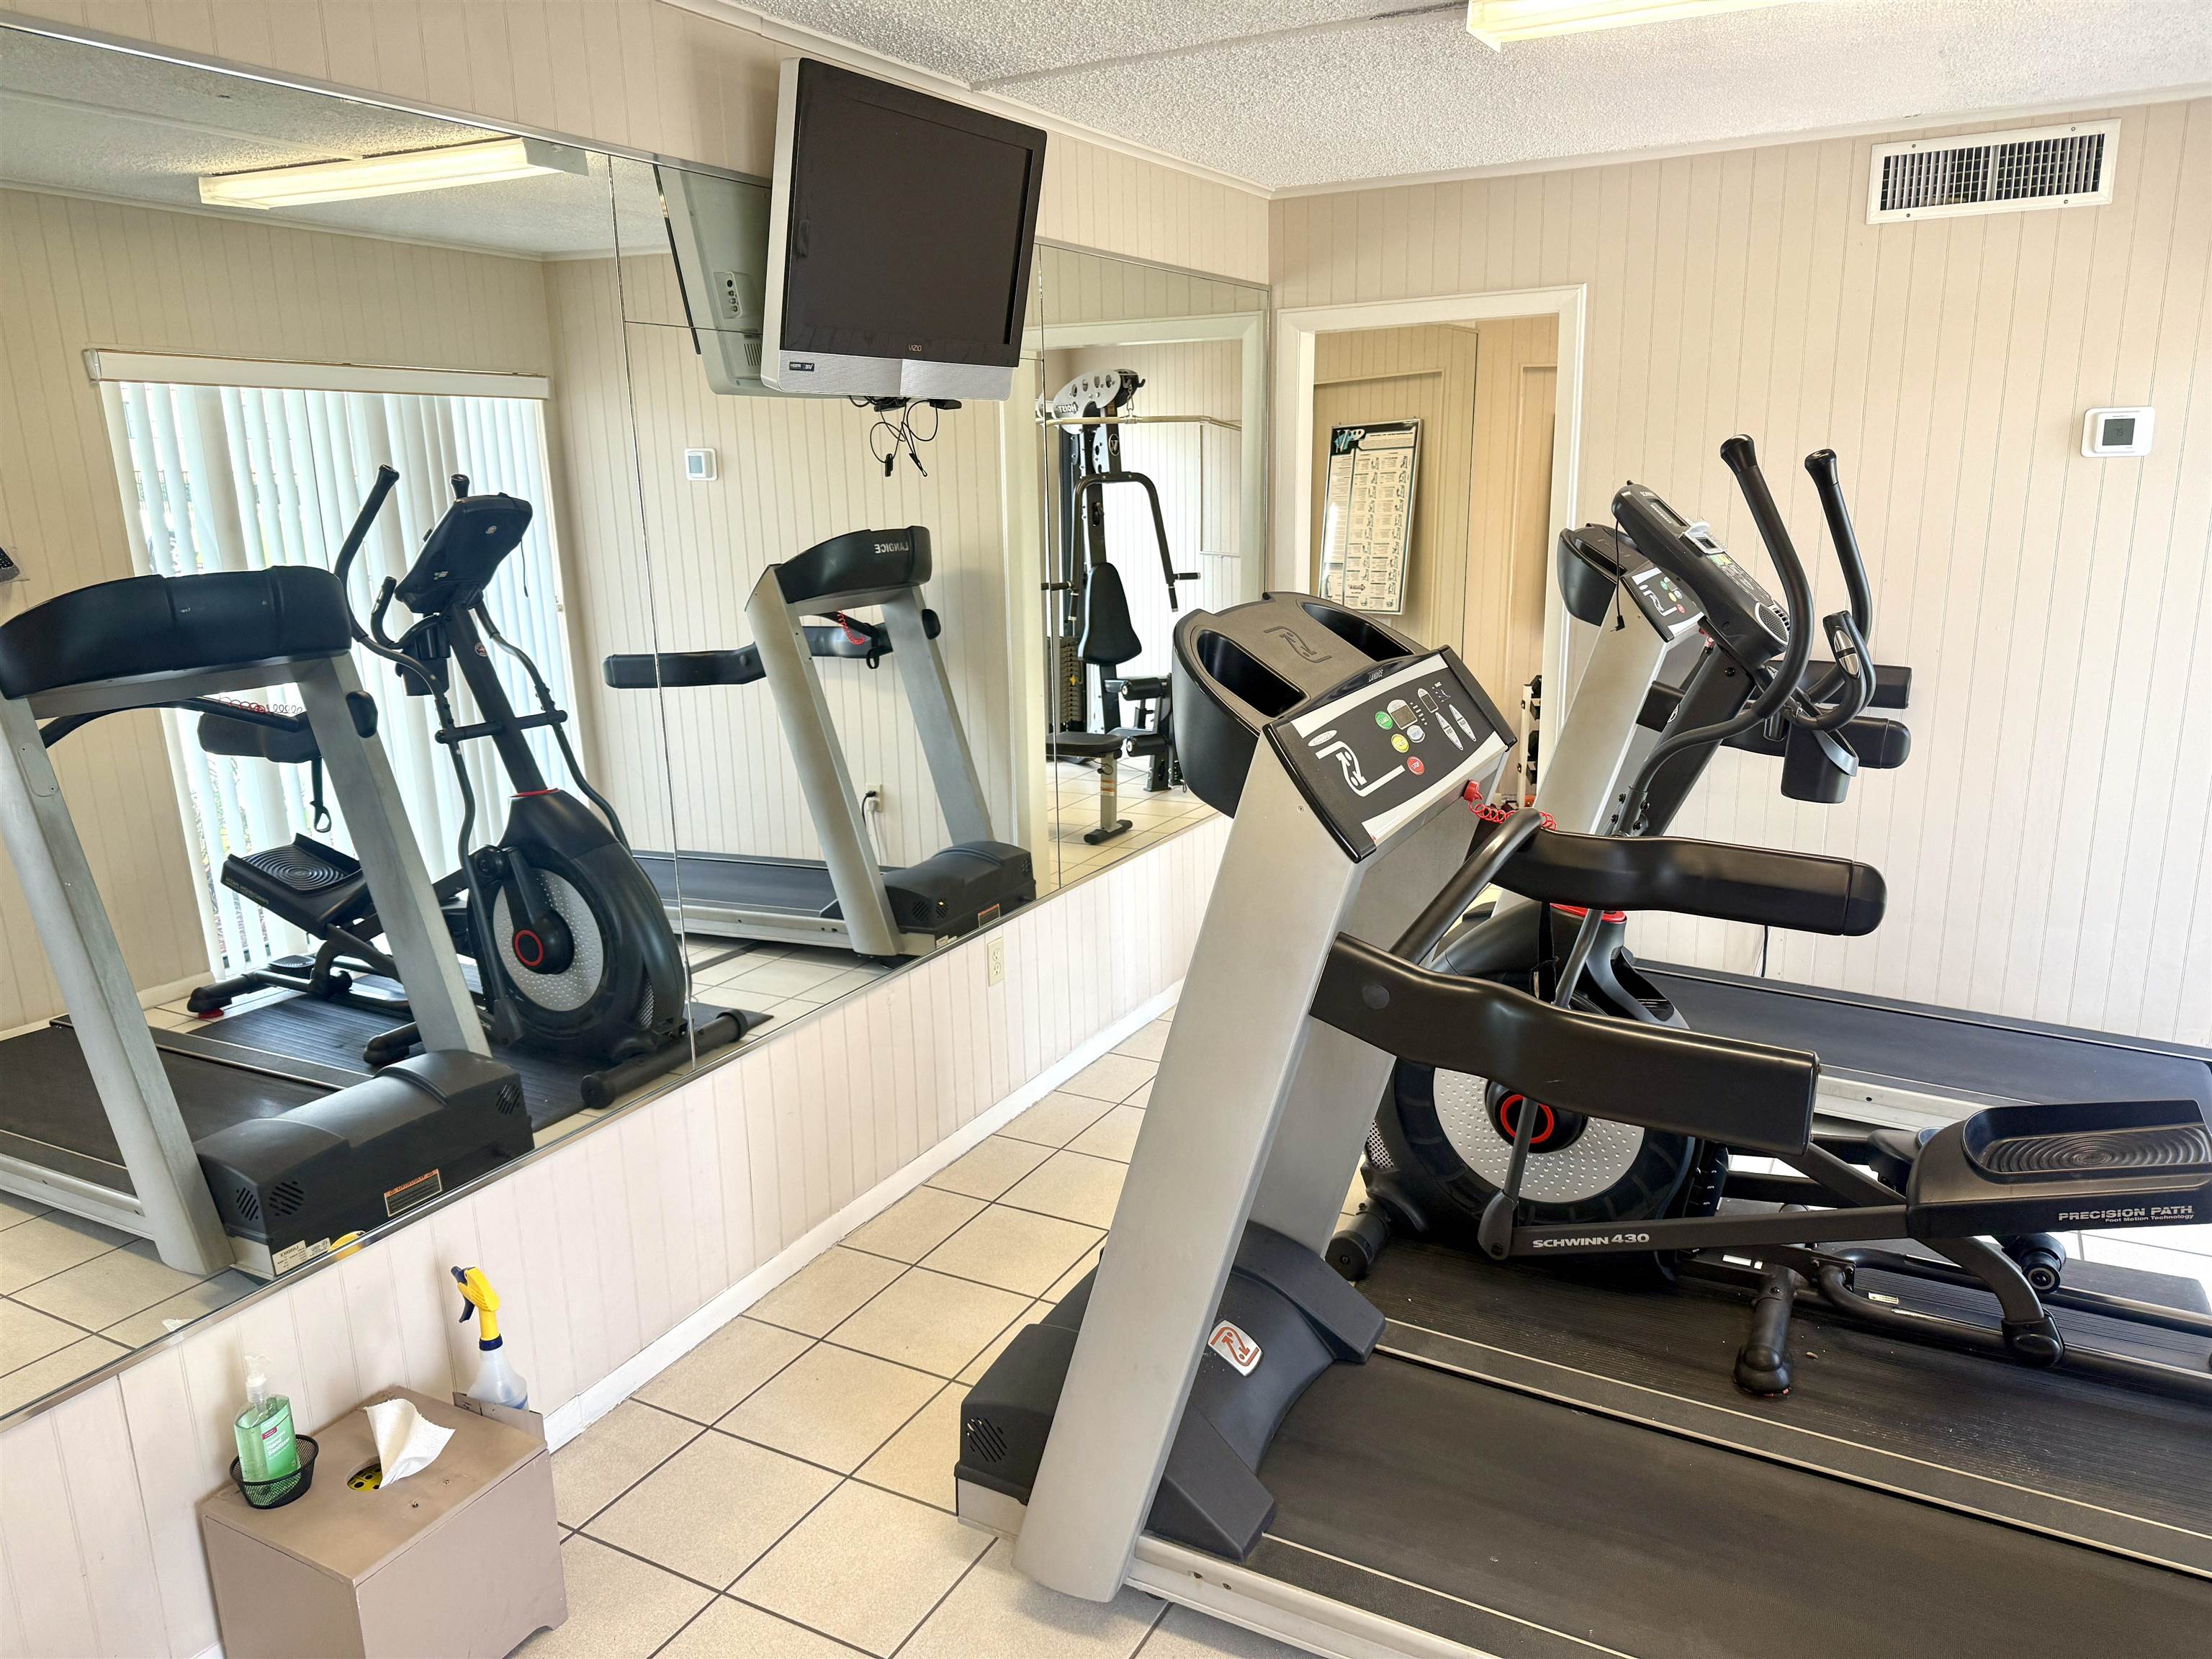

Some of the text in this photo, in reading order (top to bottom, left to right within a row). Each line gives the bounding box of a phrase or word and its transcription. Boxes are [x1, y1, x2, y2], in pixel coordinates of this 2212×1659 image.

[2058, 1205, 2193, 1220] PRECISION PATH
[1532, 1233, 1650, 1248] SCHWINN 430
[266, 1437, 282, 1450] Hand
